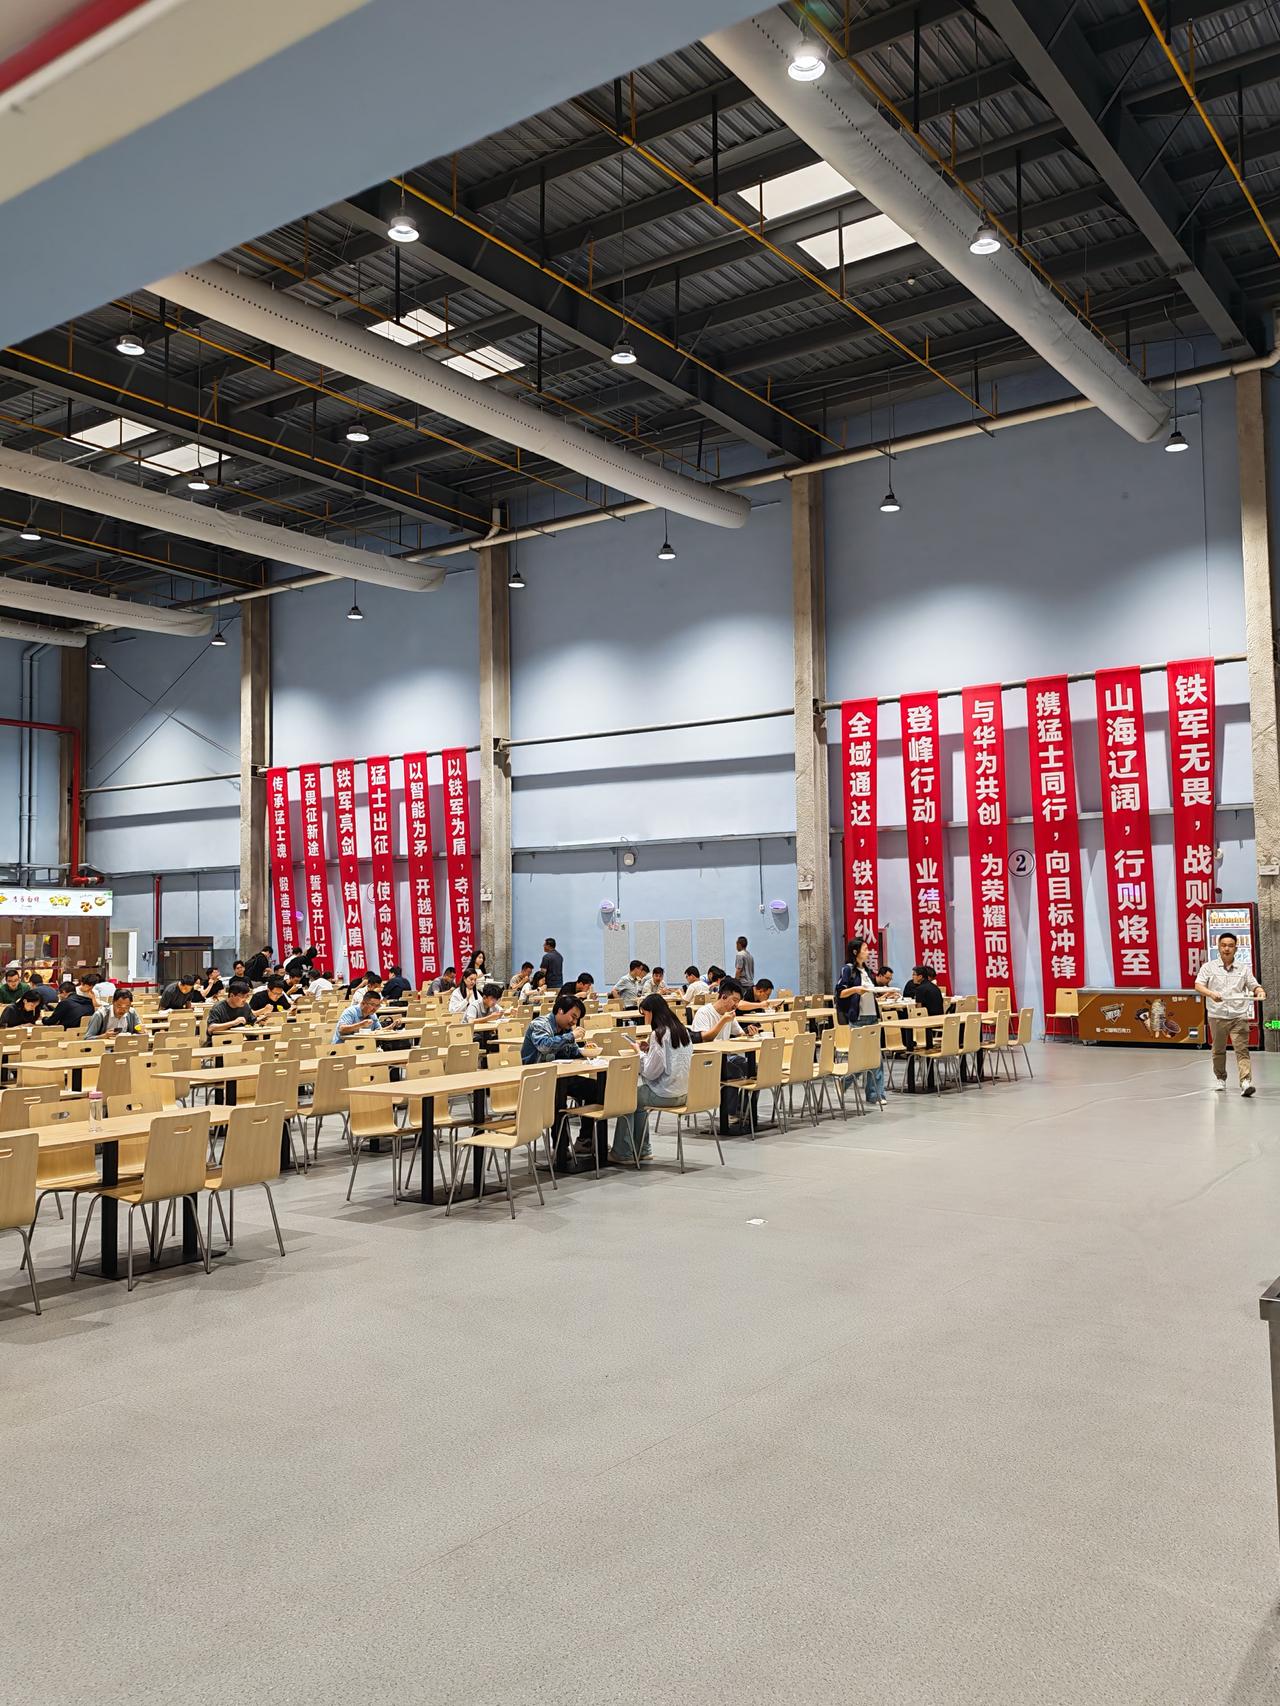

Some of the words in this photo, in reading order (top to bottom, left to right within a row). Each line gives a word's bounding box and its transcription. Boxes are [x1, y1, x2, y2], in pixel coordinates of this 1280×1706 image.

[336, 768, 365, 970] 铁军亮剑，锋从磨砺
[370, 765, 395, 971] 猛士出征，使命必达
[408, 762, 436, 974] 以智能为矛，开越野新局
[907, 705, 947, 974] 登峰行动，业绩称雄
[971, 700, 1009, 980] 与华为共创，为荣耀而战
[1014, 854, 1028, 873] 2
[1036, 691, 1076, 980] 携猛士同行，向目标冲锋
[1105, 683, 1152, 977] 山海辽阔，行则将至
